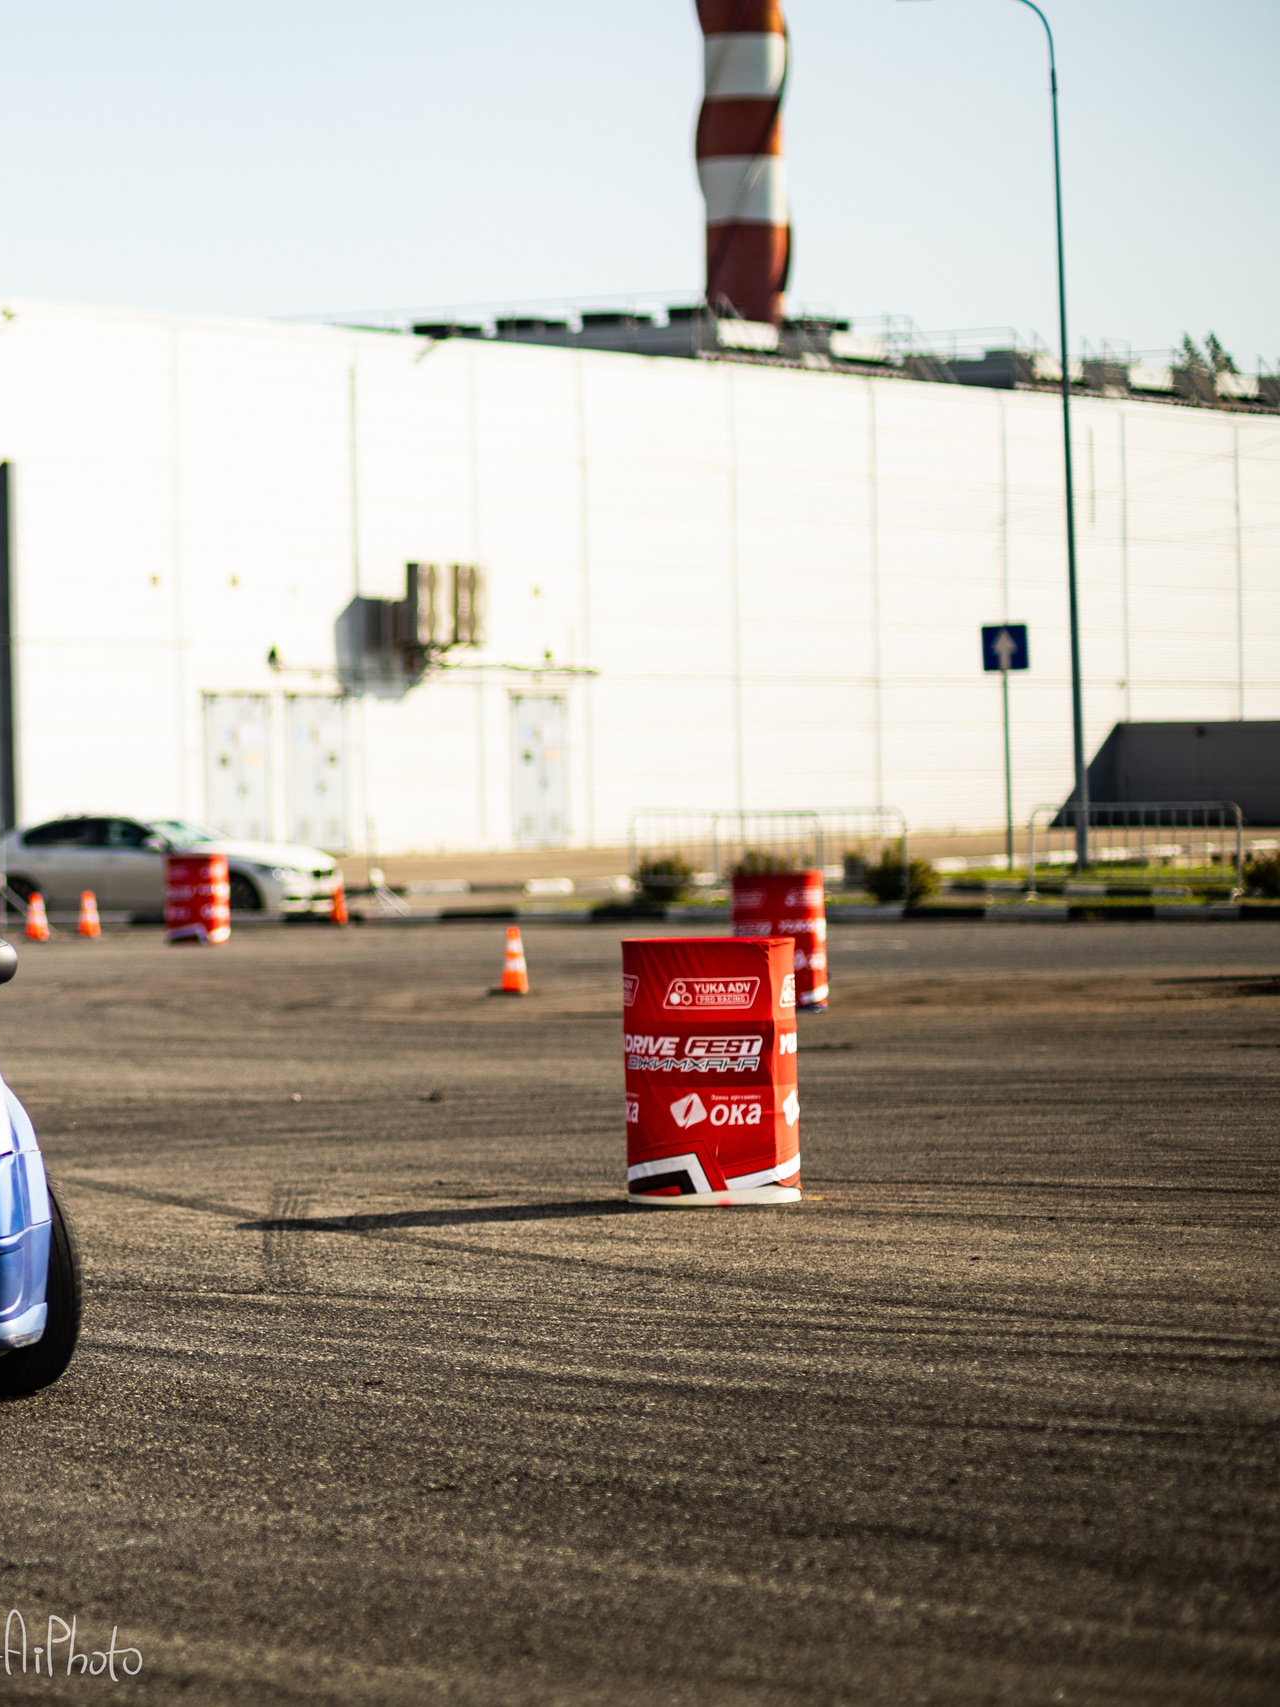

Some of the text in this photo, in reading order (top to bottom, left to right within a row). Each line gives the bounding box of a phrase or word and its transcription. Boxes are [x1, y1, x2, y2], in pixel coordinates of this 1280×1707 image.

[693, 982, 751, 994] YUKA ADV
[625, 1033, 762, 1056] DRIVE FEST
